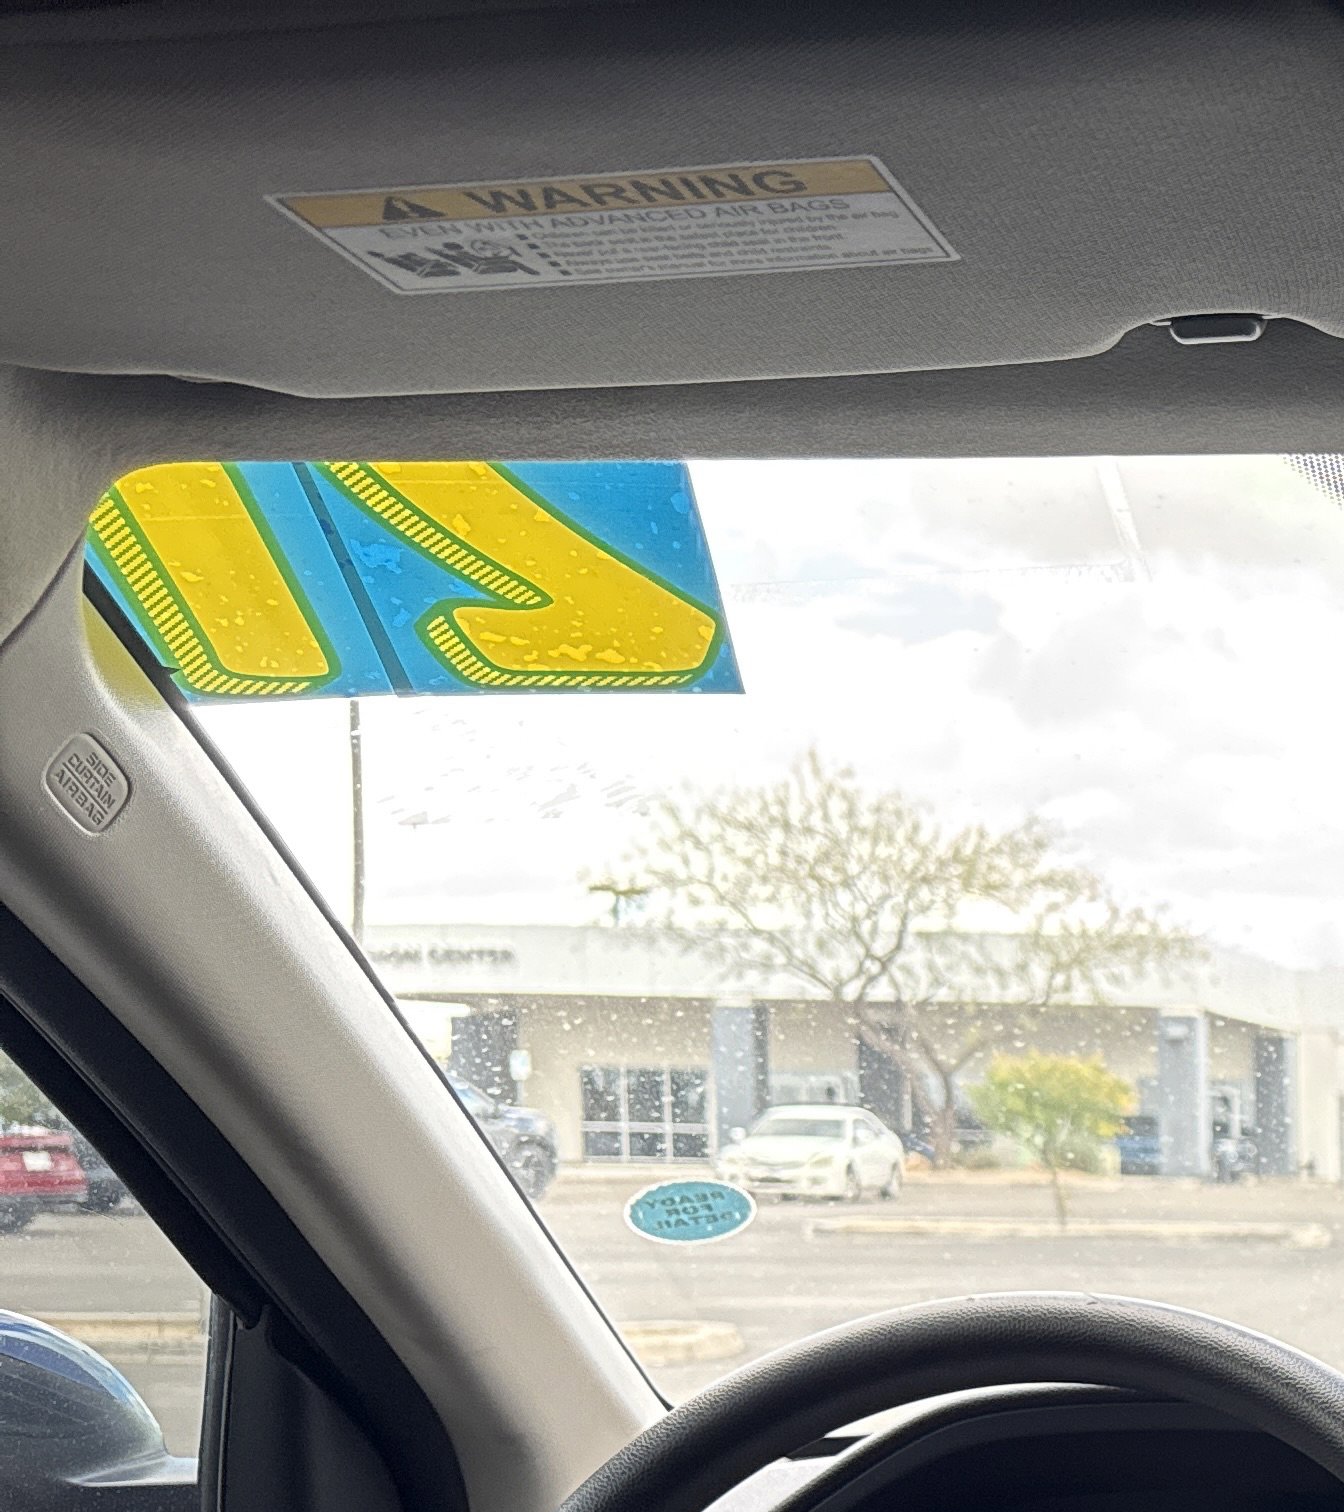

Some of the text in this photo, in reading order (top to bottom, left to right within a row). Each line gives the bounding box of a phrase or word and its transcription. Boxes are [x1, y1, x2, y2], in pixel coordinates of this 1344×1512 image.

[464, 168, 809, 213] WARNING
[379, 221, 463, 240] EVEN
[465, 217, 546, 235] WITH
[550, 207, 707, 229] ADVANCED
[714, 202, 765, 218] AIR
[766, 198, 851, 215] BAGS
[67, 752, 116, 809] CURTAIN
[85, 751, 117, 788] SIDE
[55, 769, 105, 826] AIRBAG
